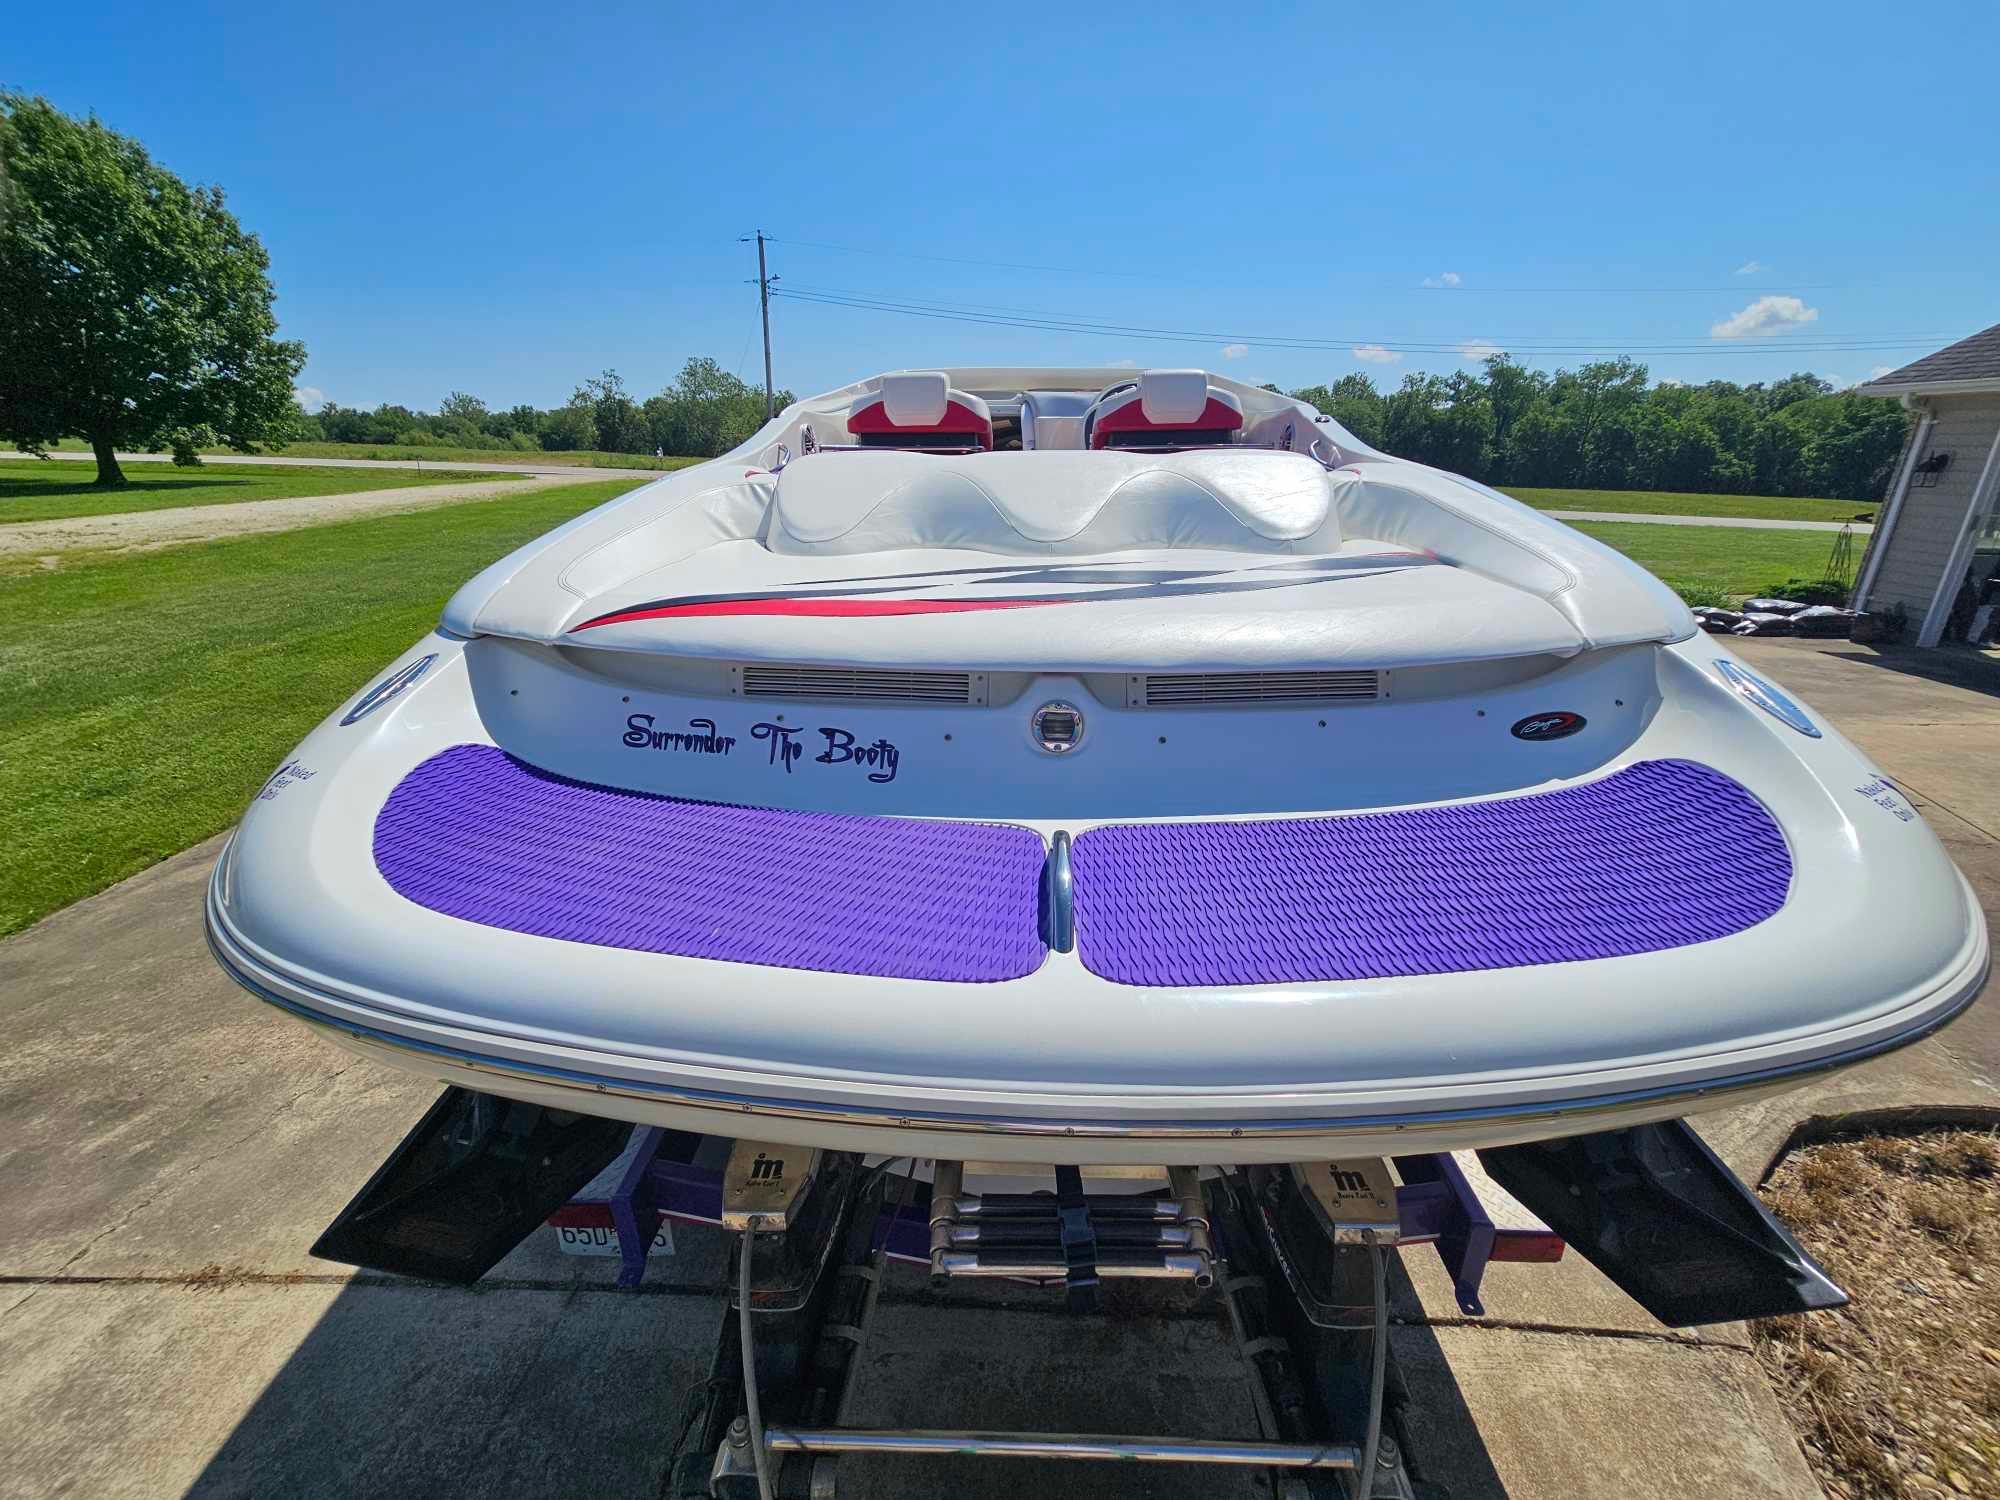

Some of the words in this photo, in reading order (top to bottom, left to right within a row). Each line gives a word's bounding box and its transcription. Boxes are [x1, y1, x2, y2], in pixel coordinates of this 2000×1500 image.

[622, 713, 737, 756] Surrender
[750, 722, 804, 774] The
[815, 727, 900, 784] Booty
